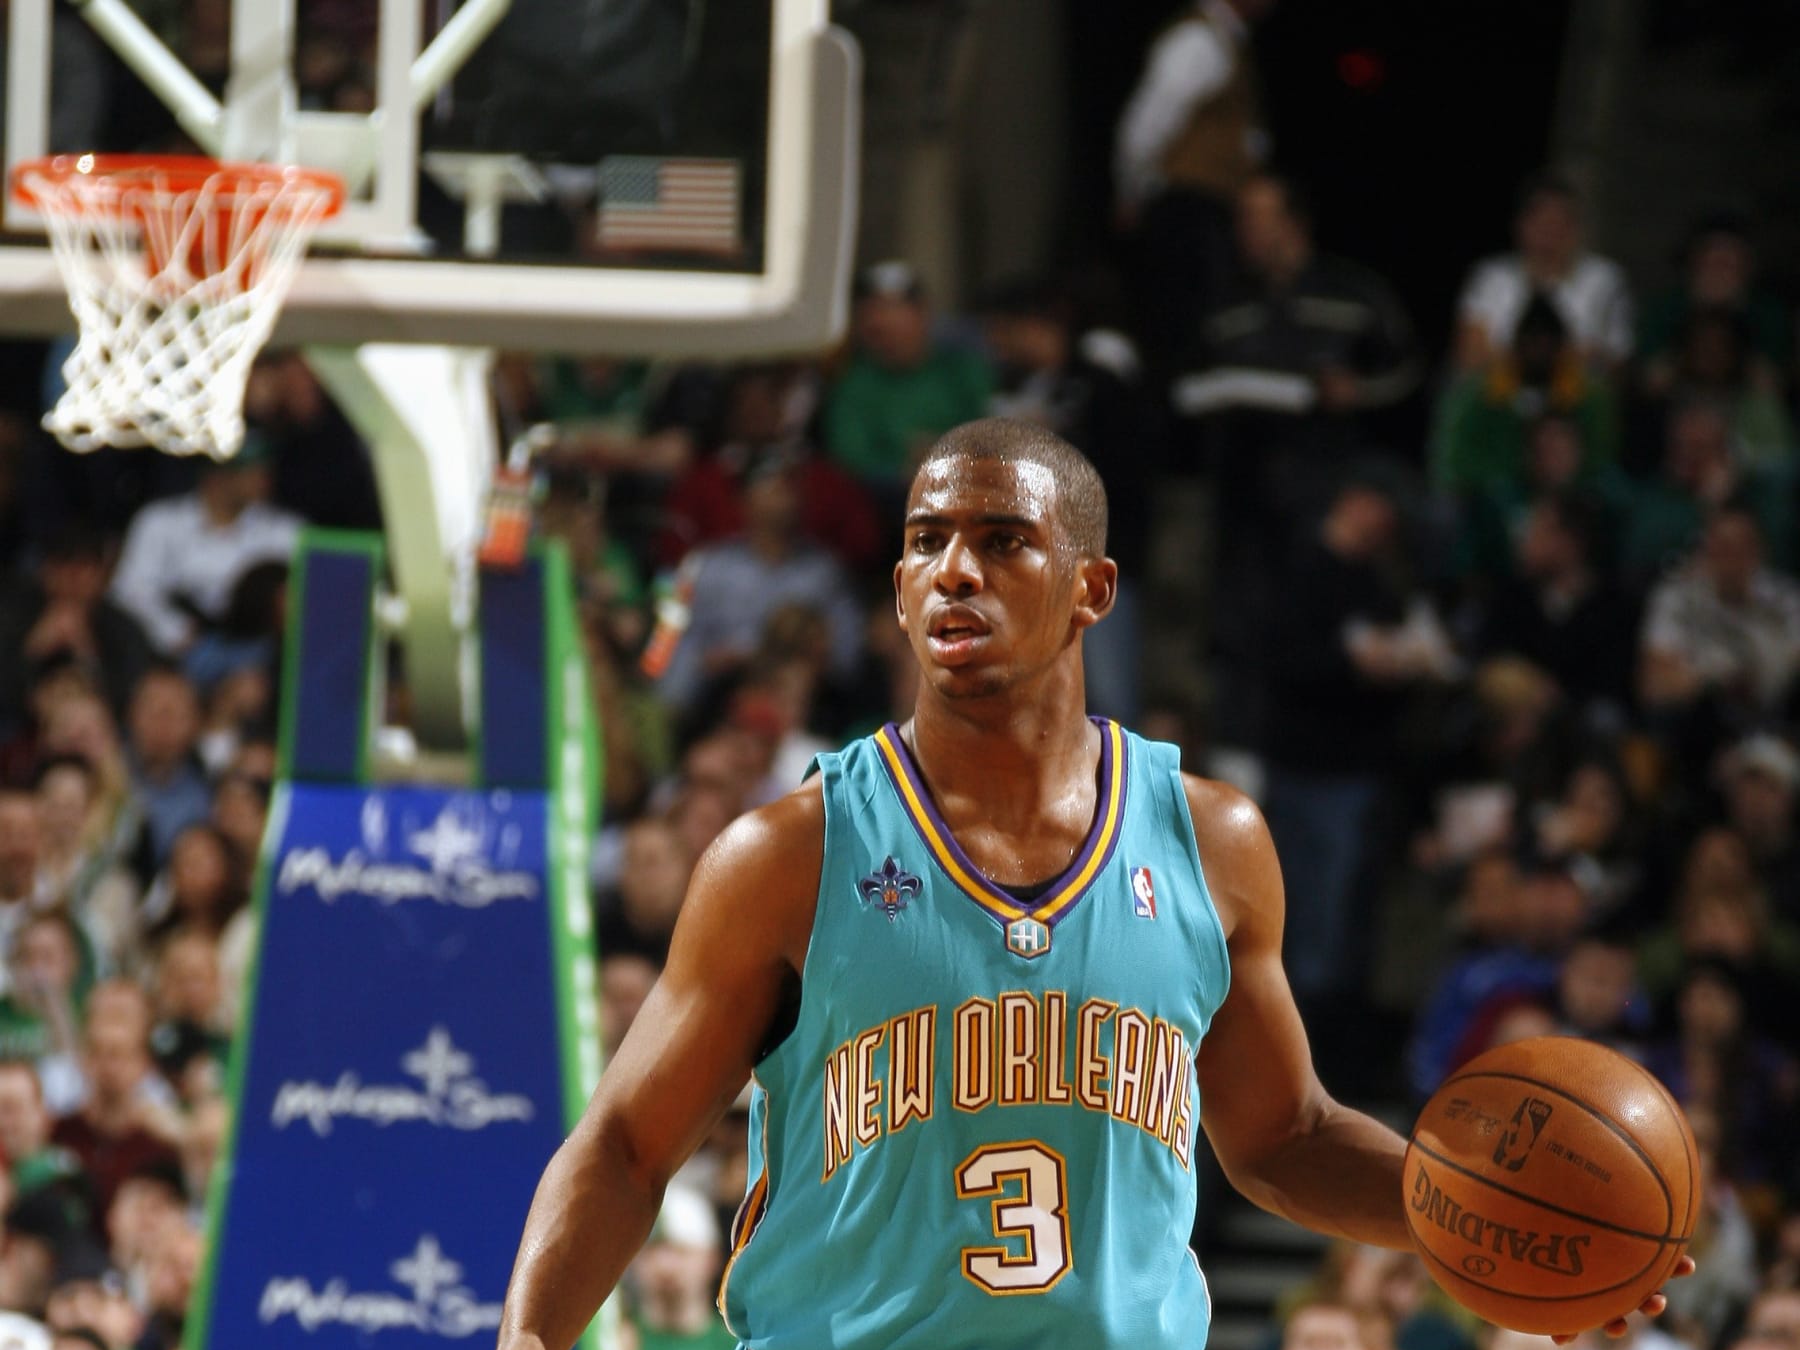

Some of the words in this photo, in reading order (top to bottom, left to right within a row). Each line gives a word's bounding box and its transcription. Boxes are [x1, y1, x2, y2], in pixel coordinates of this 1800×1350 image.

[821, 1004, 937, 1183] NEW
[952, 990, 1193, 1173] ORLEANS
[954, 1138, 1074, 1296] 3
[1411, 1164, 1592, 1277] SPALDING
